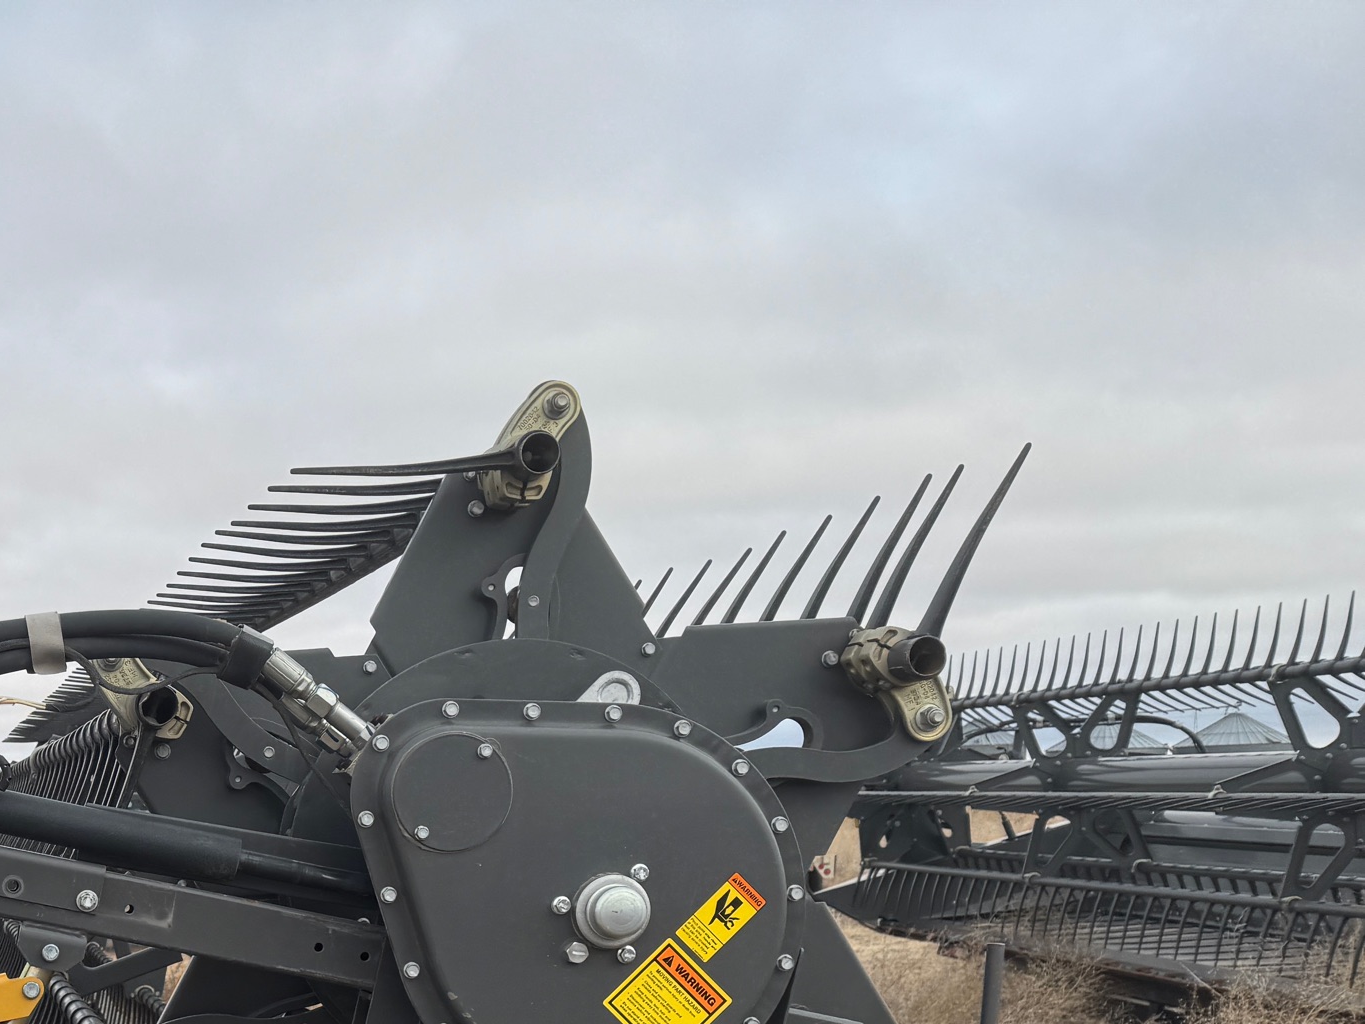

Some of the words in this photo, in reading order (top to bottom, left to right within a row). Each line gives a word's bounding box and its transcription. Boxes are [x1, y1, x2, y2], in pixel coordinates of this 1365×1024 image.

[734, 879, 763, 907] WARNING
[654, 968, 674, 986] MOVING
[681, 995, 702, 1014] HAZARD
[672, 963, 718, 1007] WARNING
